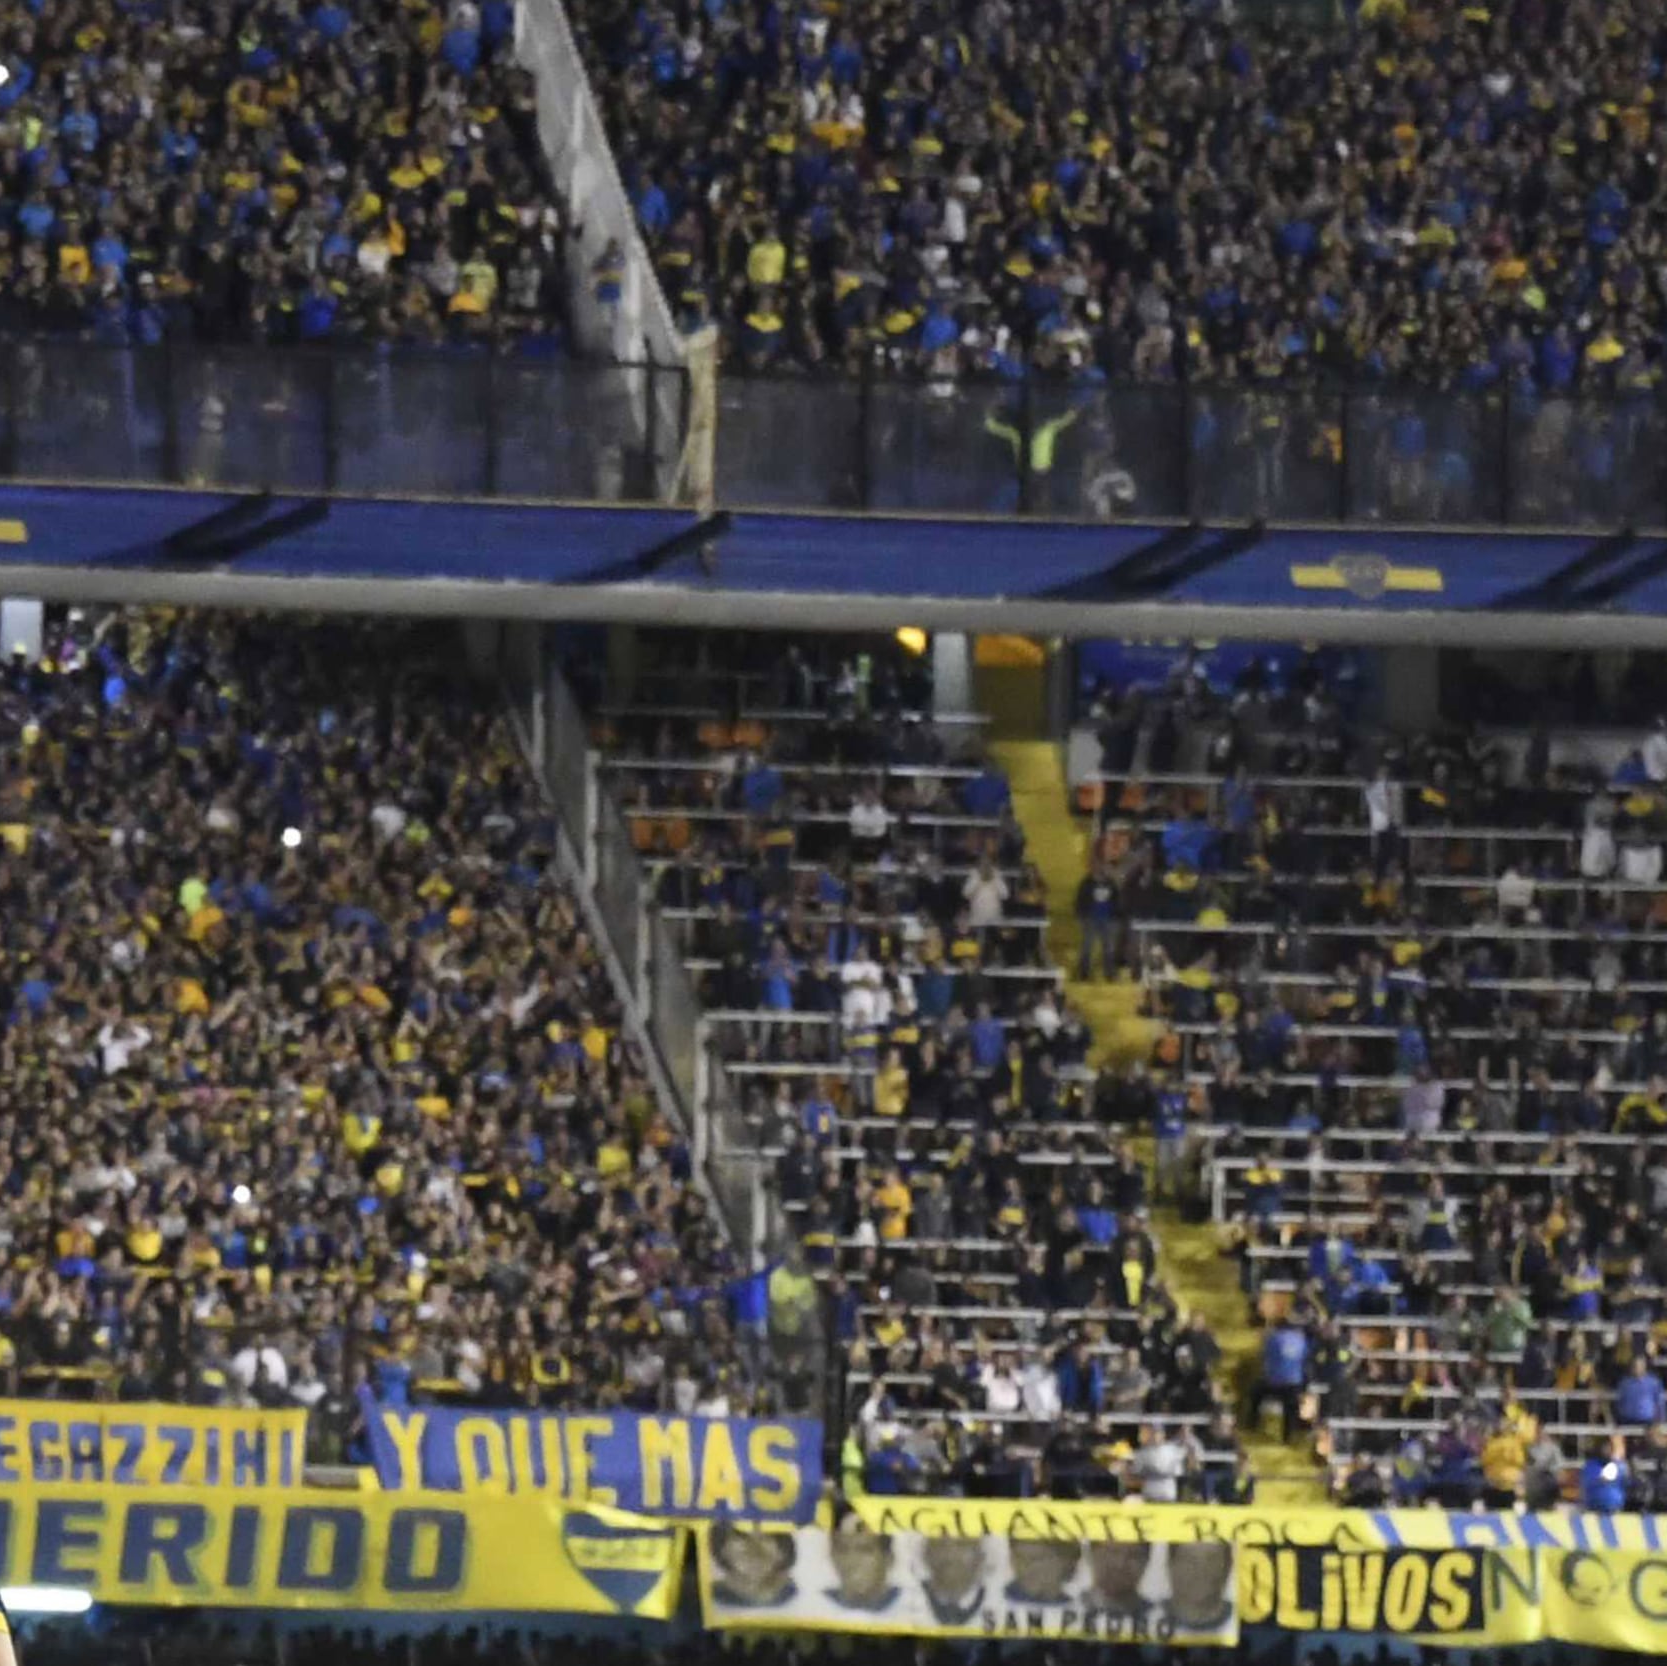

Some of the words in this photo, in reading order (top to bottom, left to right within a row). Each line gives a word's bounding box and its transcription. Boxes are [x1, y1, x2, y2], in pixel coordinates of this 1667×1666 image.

[380, 1410, 427, 1490] Y
[454, 1414, 619, 1509] QUE
[637, 1417, 803, 1512] MAS
